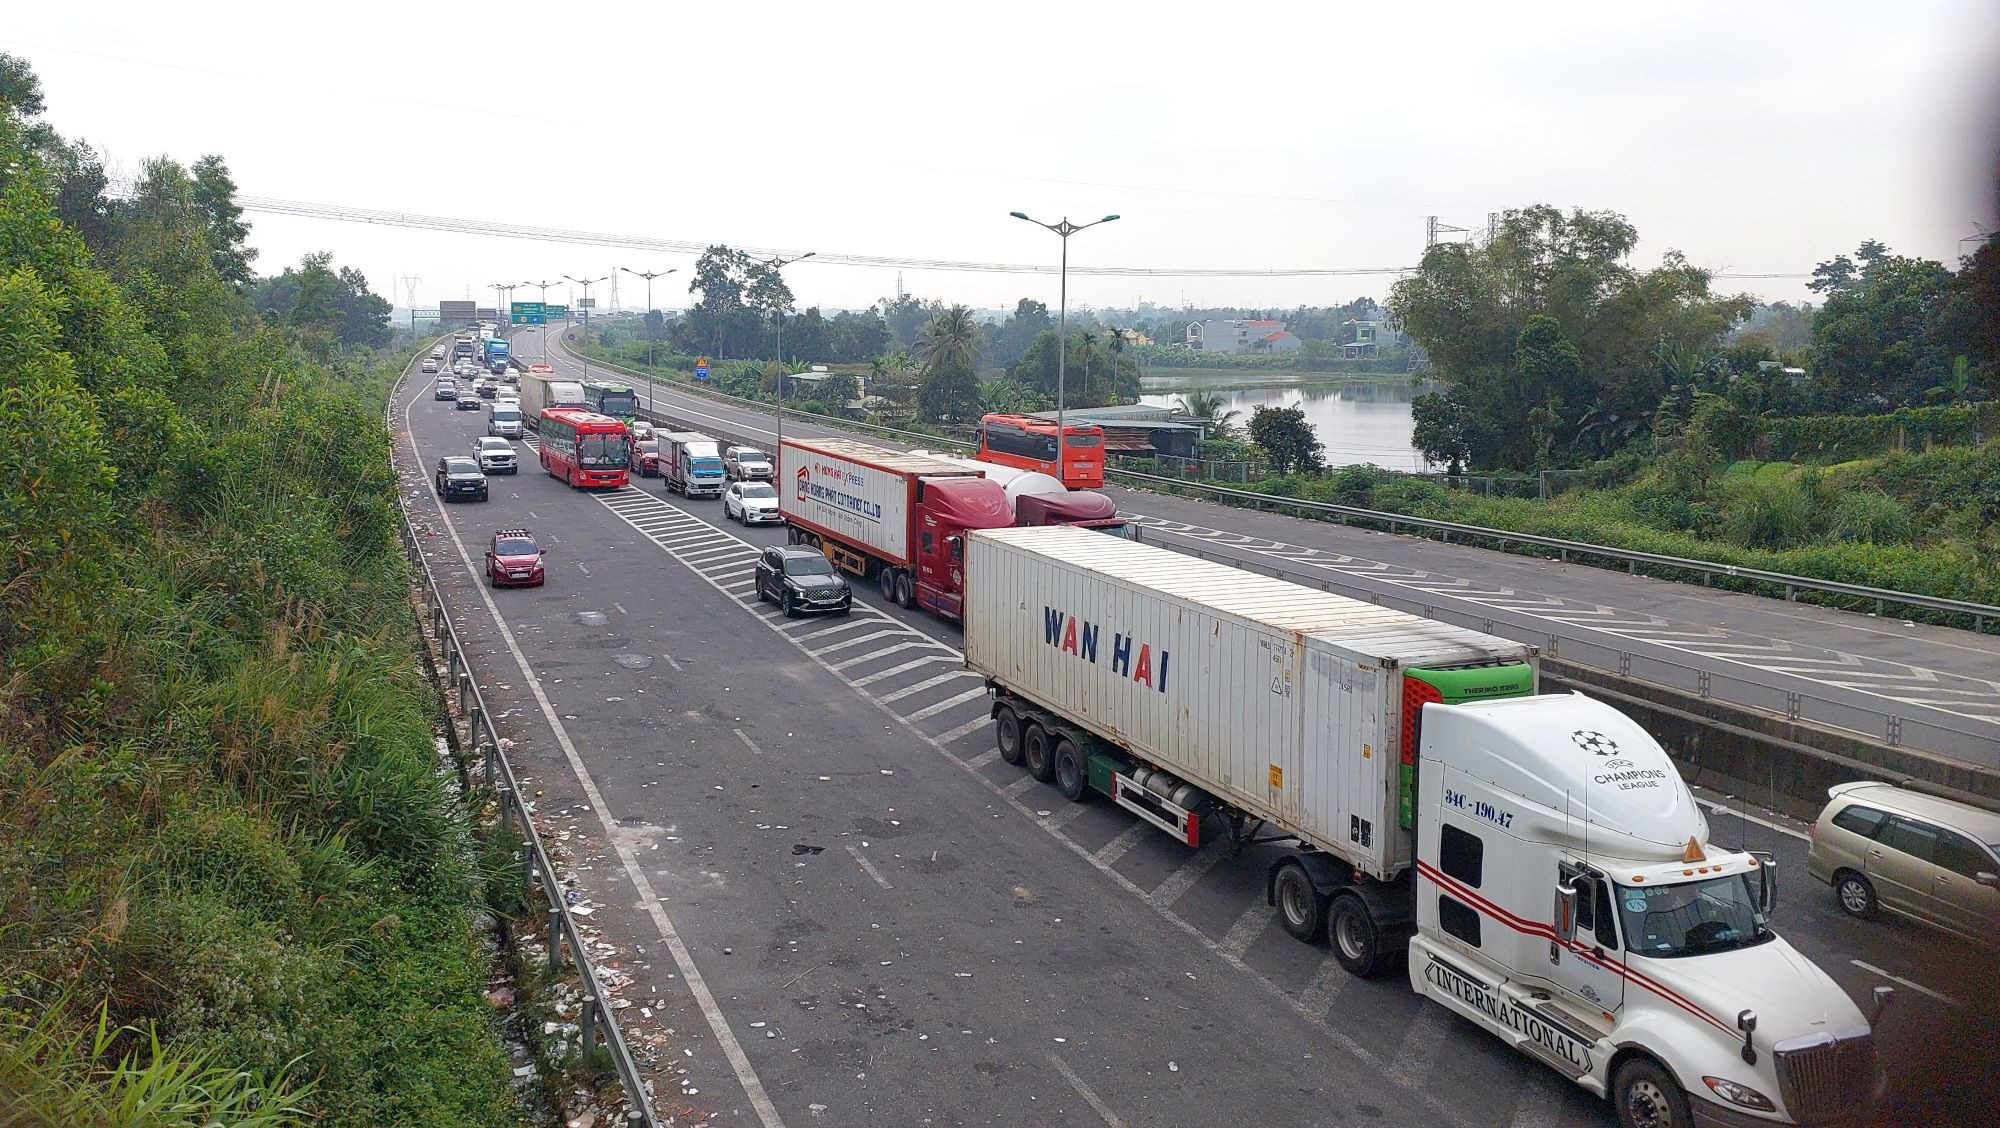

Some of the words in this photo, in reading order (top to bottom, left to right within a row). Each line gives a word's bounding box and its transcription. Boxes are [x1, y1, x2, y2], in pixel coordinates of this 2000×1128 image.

[838, 492, 862, 512] CONTAINER
[1045, 606, 1098, 664] WAN
[1112, 633, 1168, 693] HAI
[1499, 684, 1519, 692] KING
[1594, 770, 1666, 784] CHAMPIONS
[1618, 781, 1659, 790] LEAGUE
[1629, 902, 1645, 910] VN
[1435, 966, 1580, 1066] INTERNATIONAL
